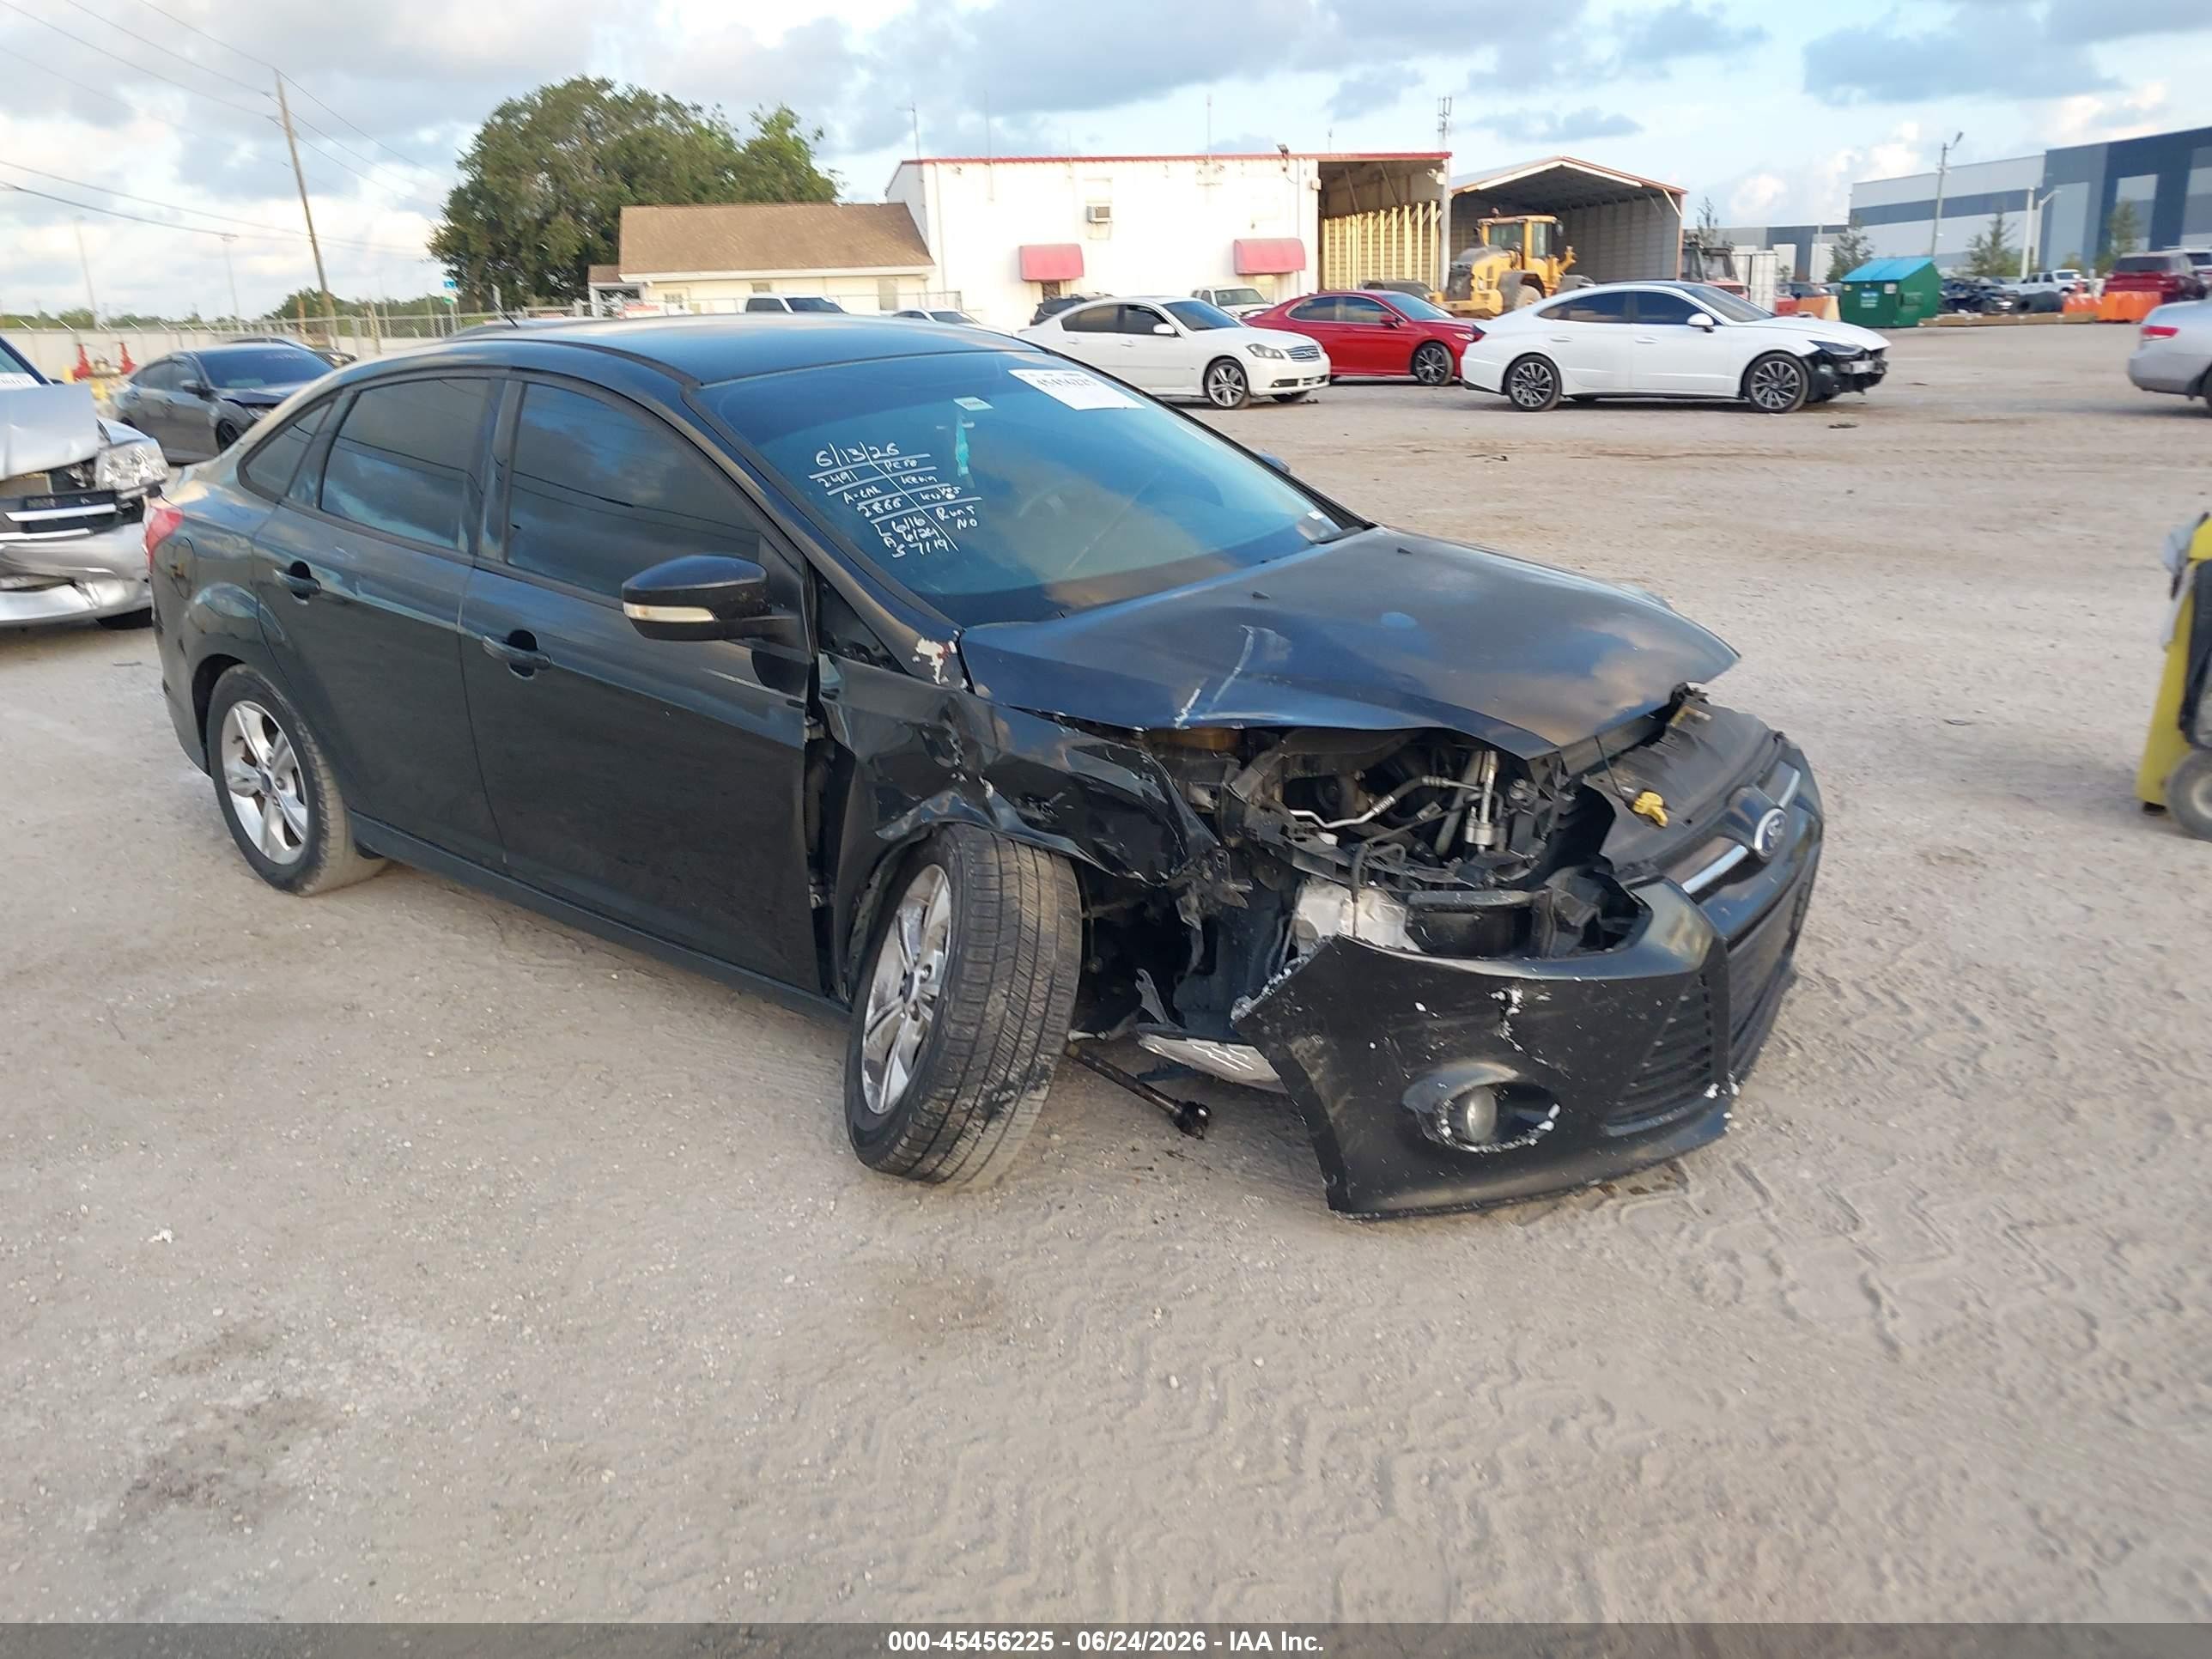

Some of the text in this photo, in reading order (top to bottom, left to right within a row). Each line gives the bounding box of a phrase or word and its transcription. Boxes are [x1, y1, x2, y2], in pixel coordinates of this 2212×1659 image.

[816, 441, 900, 467] 6/13/26
[817, 470, 859, 488] 2491
[957, 518, 978, 531] NO
